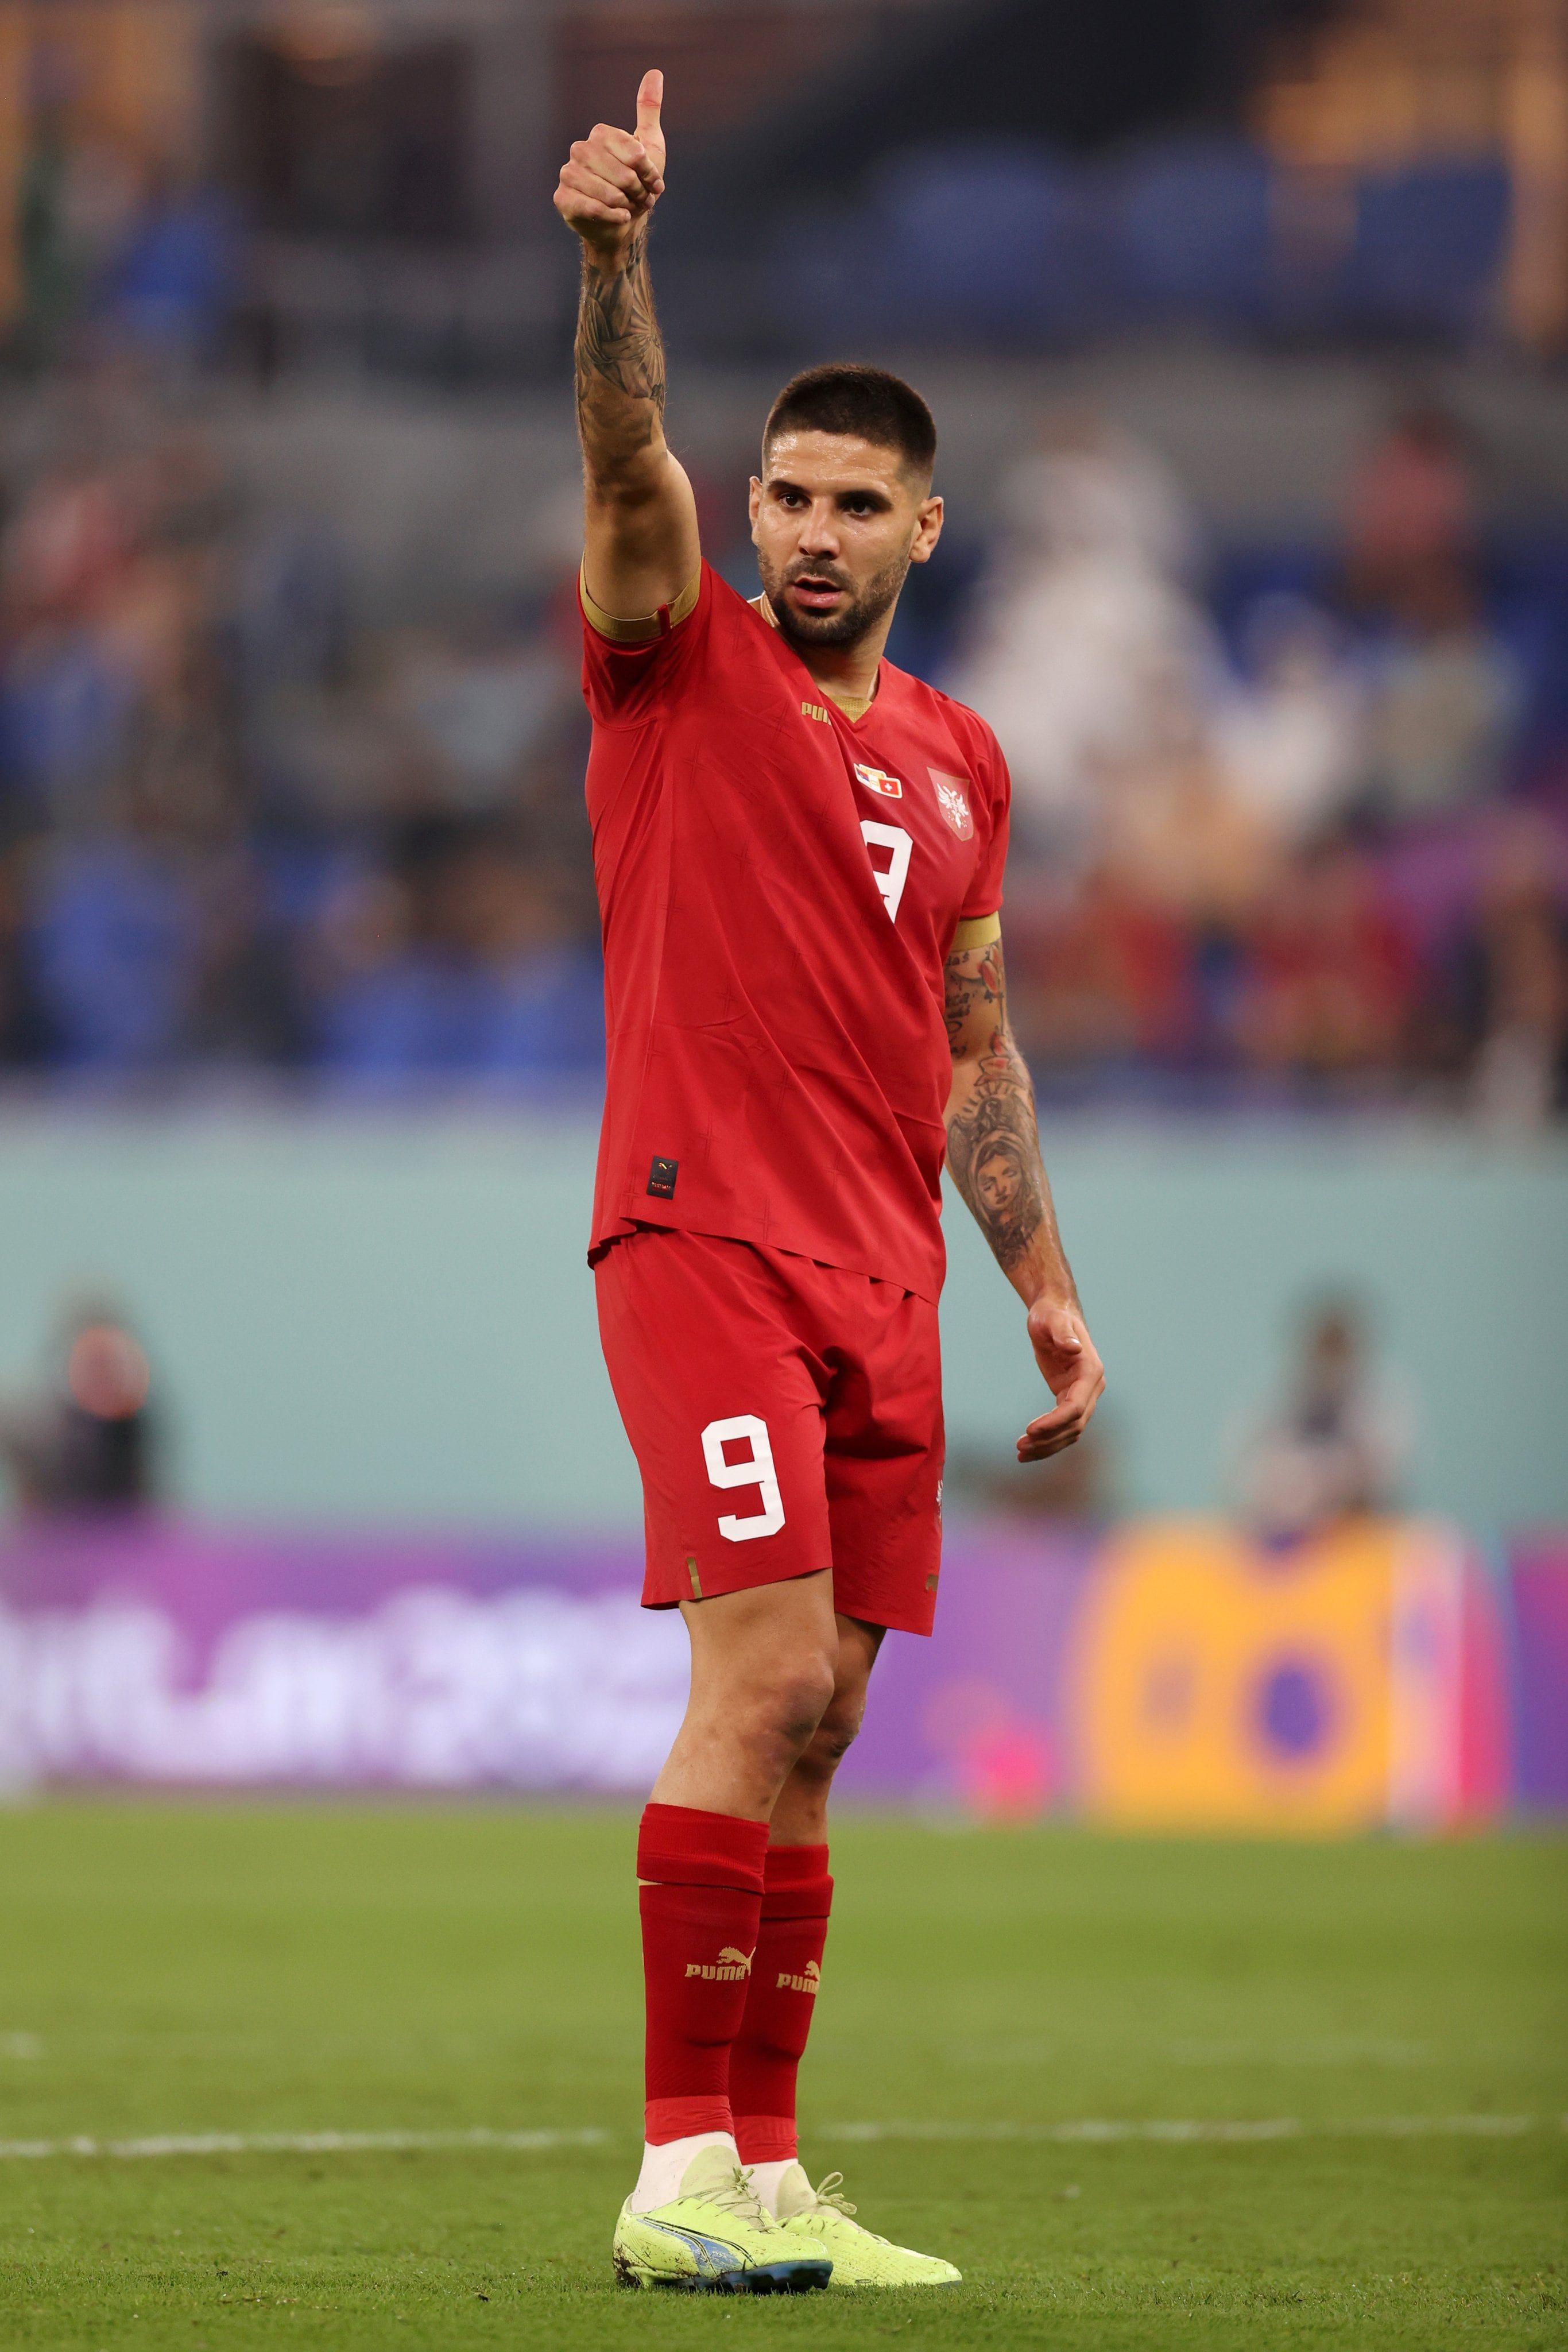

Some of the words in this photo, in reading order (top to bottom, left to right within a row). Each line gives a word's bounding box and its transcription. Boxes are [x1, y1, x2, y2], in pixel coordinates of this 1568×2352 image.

[860, 819, 913, 924] 9
[700, 1414, 785, 1542] 9
[684, 1964, 746, 1980] PUMA
